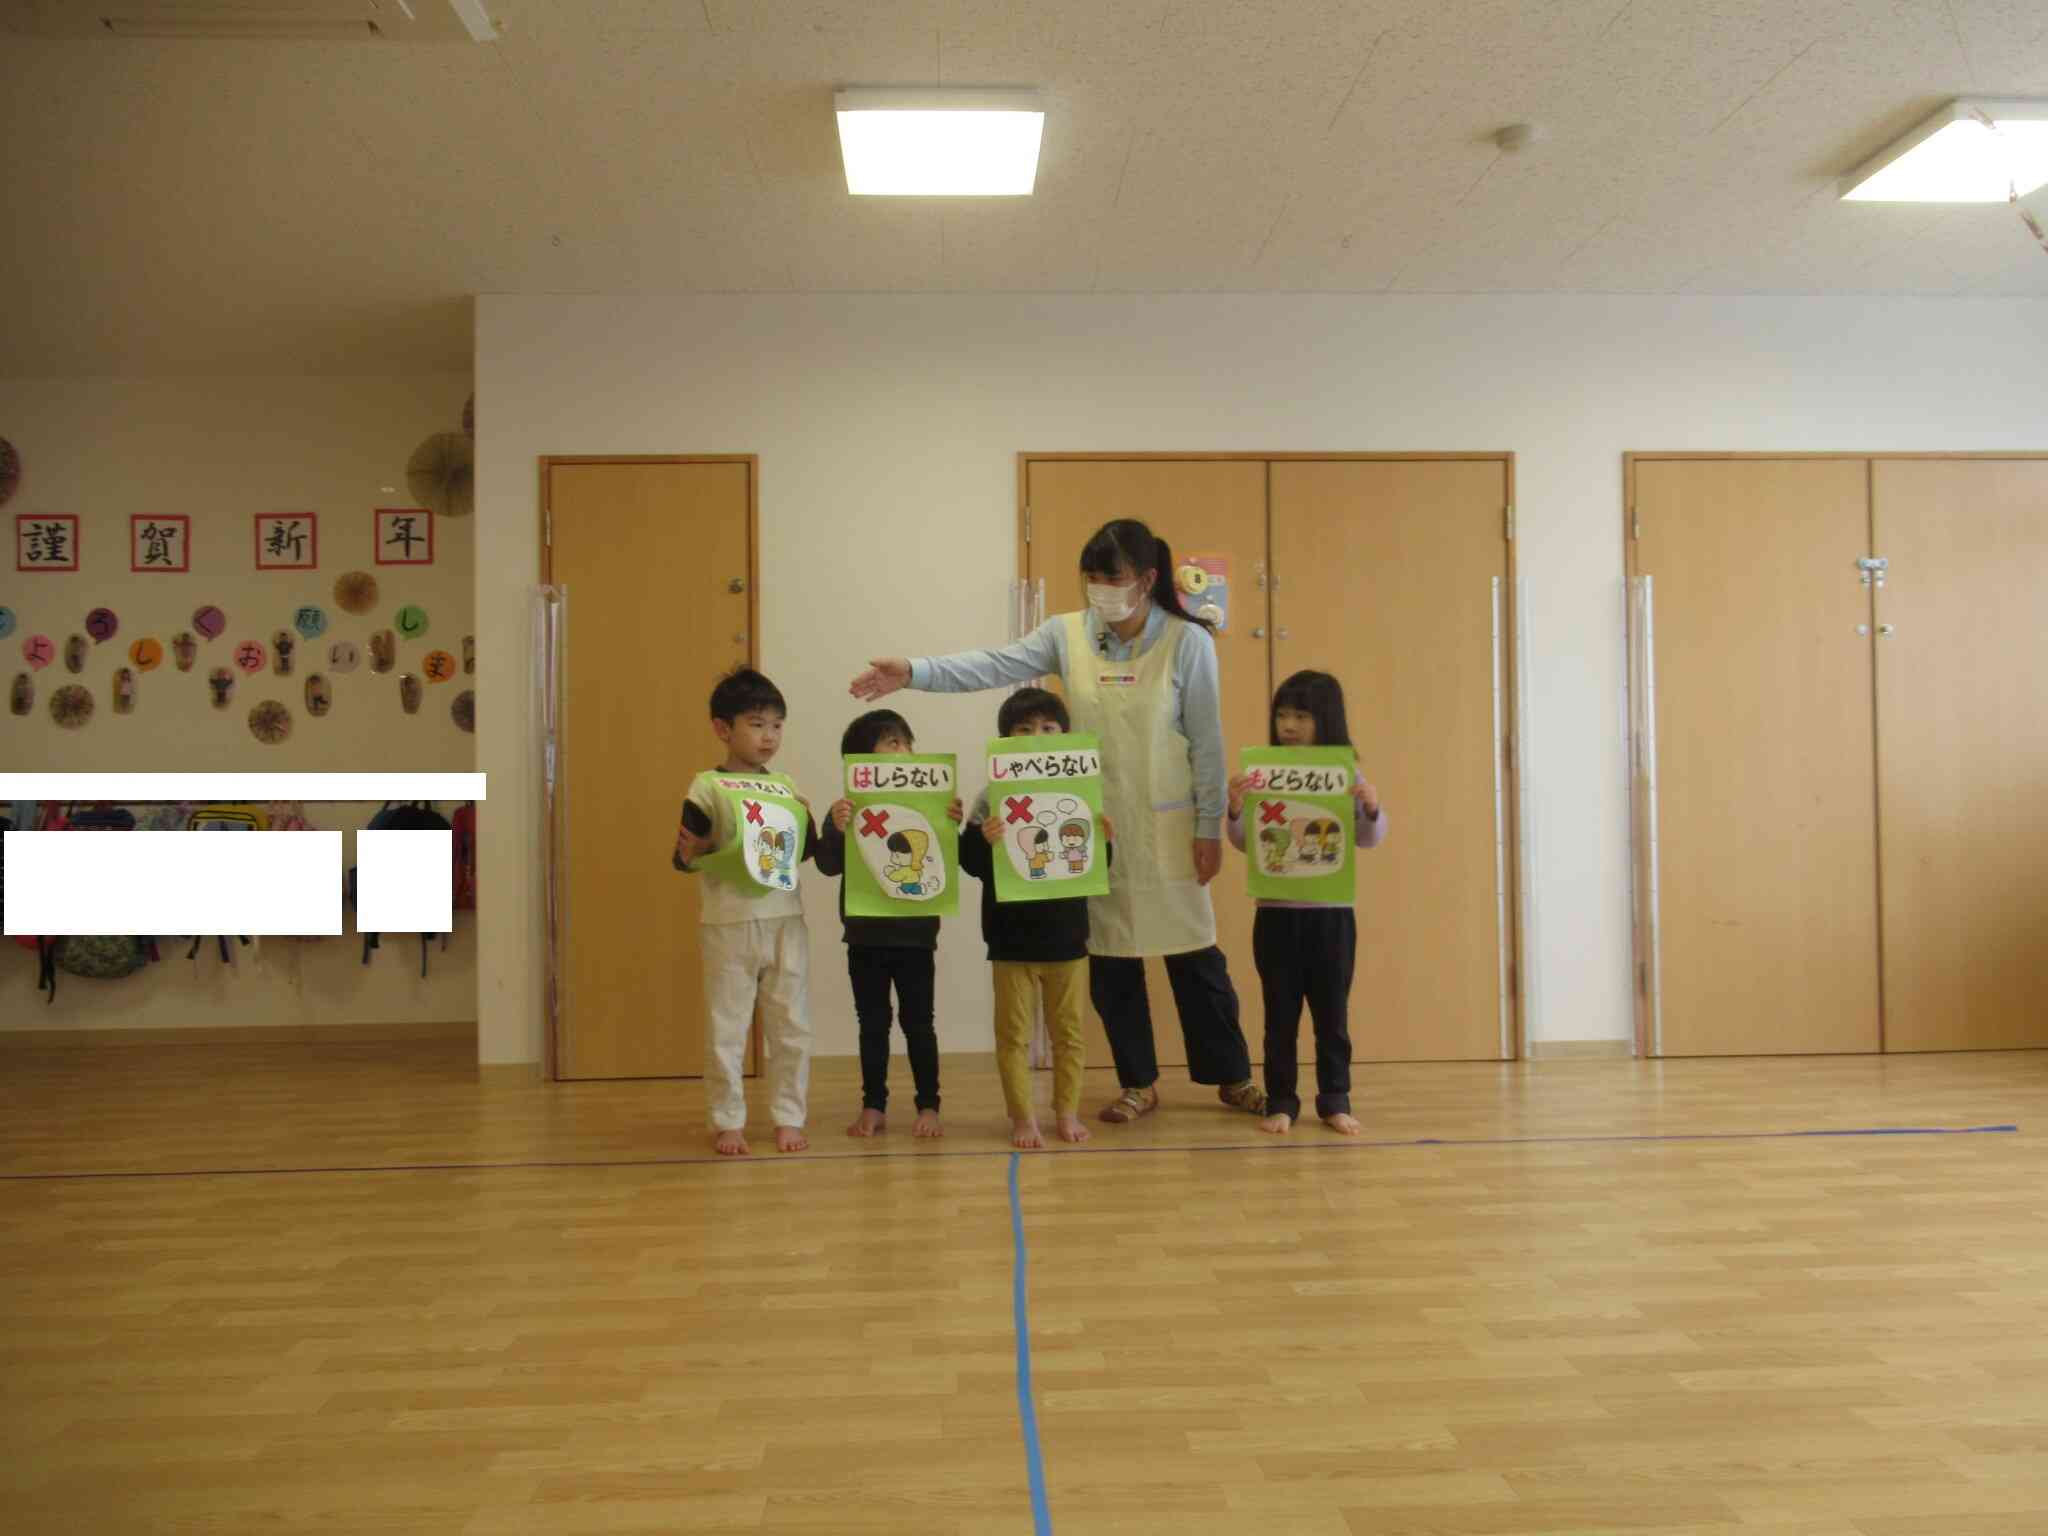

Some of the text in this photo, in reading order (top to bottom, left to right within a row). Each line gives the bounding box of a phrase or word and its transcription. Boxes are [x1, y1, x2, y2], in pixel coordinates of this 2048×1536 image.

[22, 516, 425, 566] 謹 賀 新 年
[239, 644, 262, 667] お
[853, 766, 950, 789] はしらない
[992, 754, 1098, 780] しゃべらない
[1248, 768, 1345, 792] もどらない
